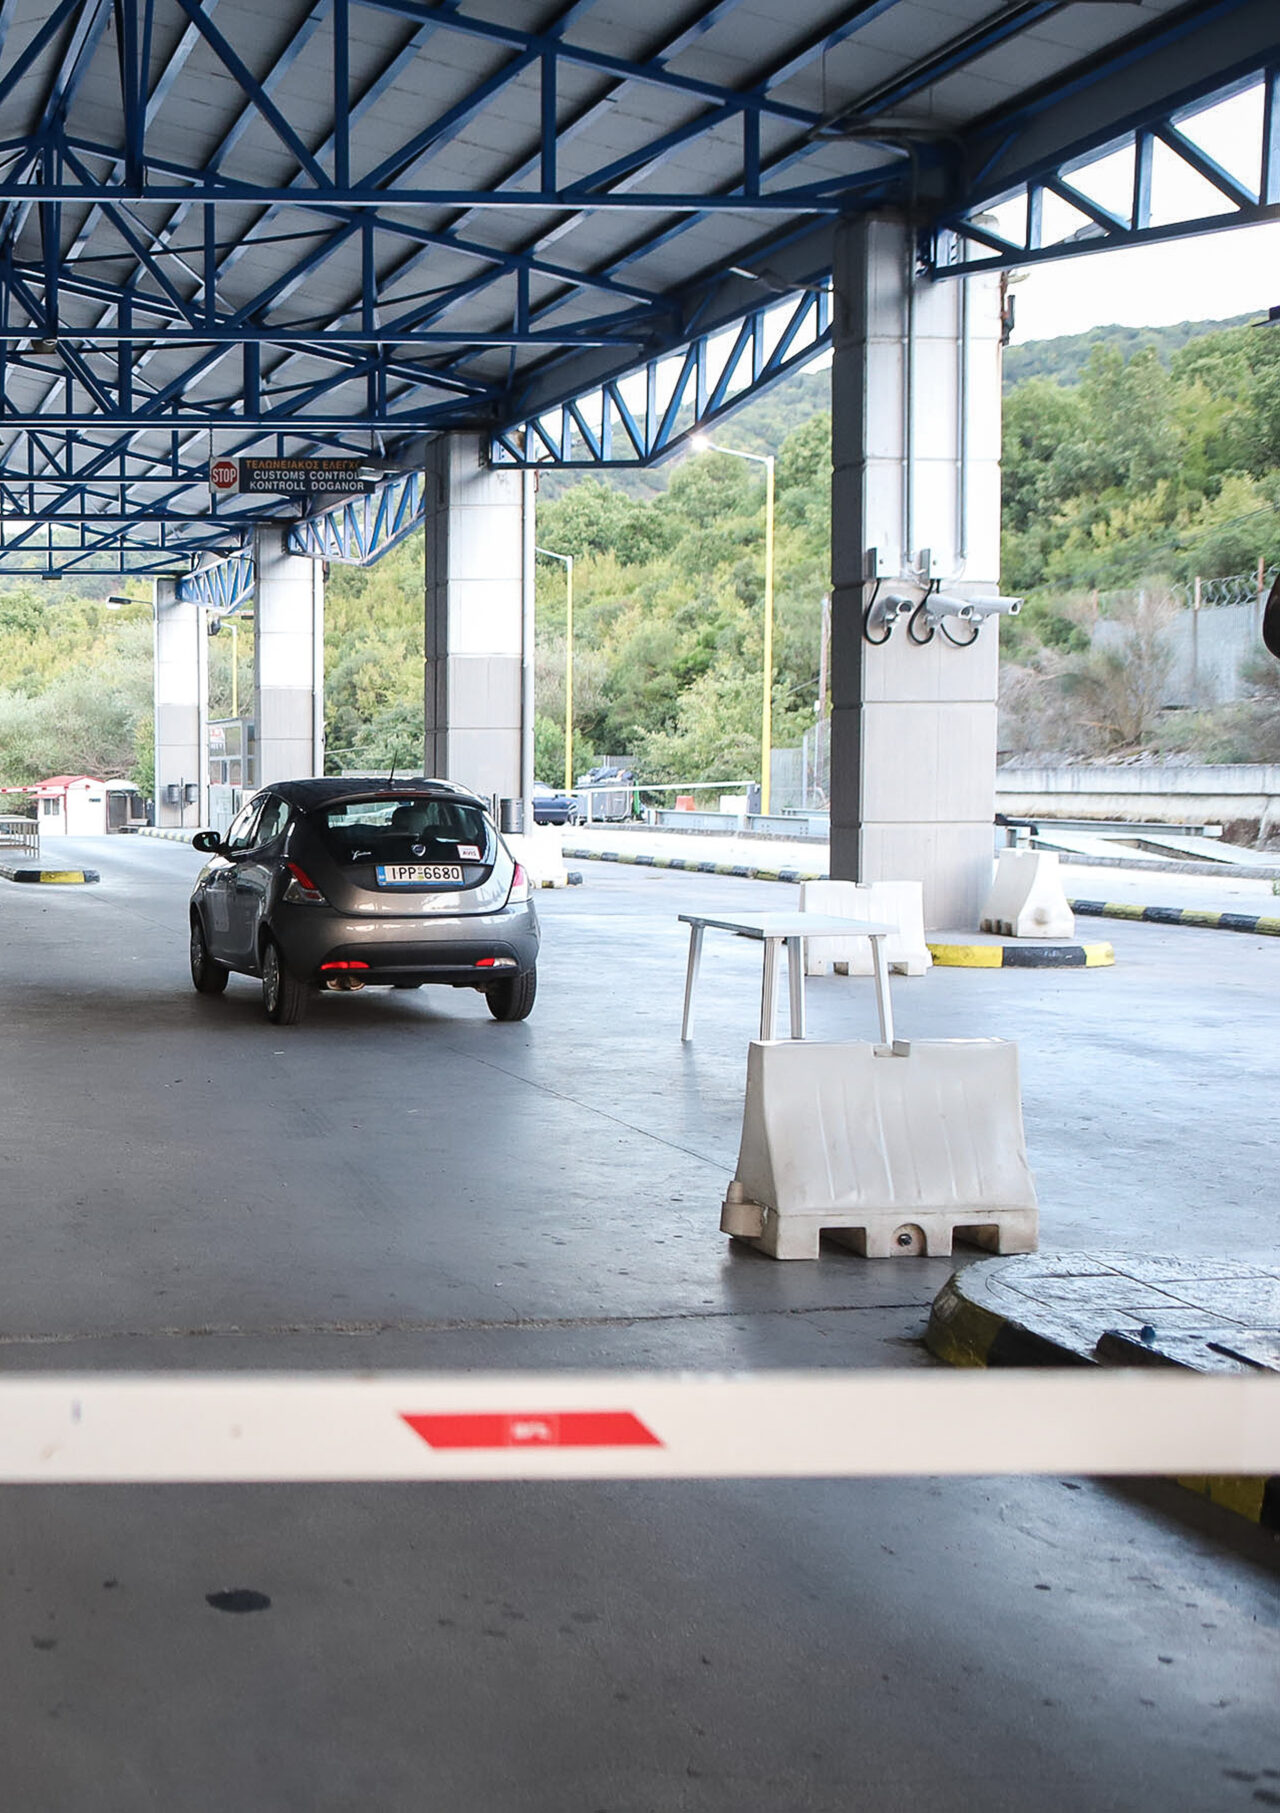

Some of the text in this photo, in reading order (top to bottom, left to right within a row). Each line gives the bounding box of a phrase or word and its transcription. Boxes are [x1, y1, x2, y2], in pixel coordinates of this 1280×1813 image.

[246, 460, 361, 470] ΤΕΛΩΝΕΙΑΚΟΣ ΕΛΕΓΧ
[212, 468, 237, 483] STOP
[253, 470, 360, 480] CUSTOMS CONTROL
[249, 481, 365, 491] KONTROLL DOGANOR
